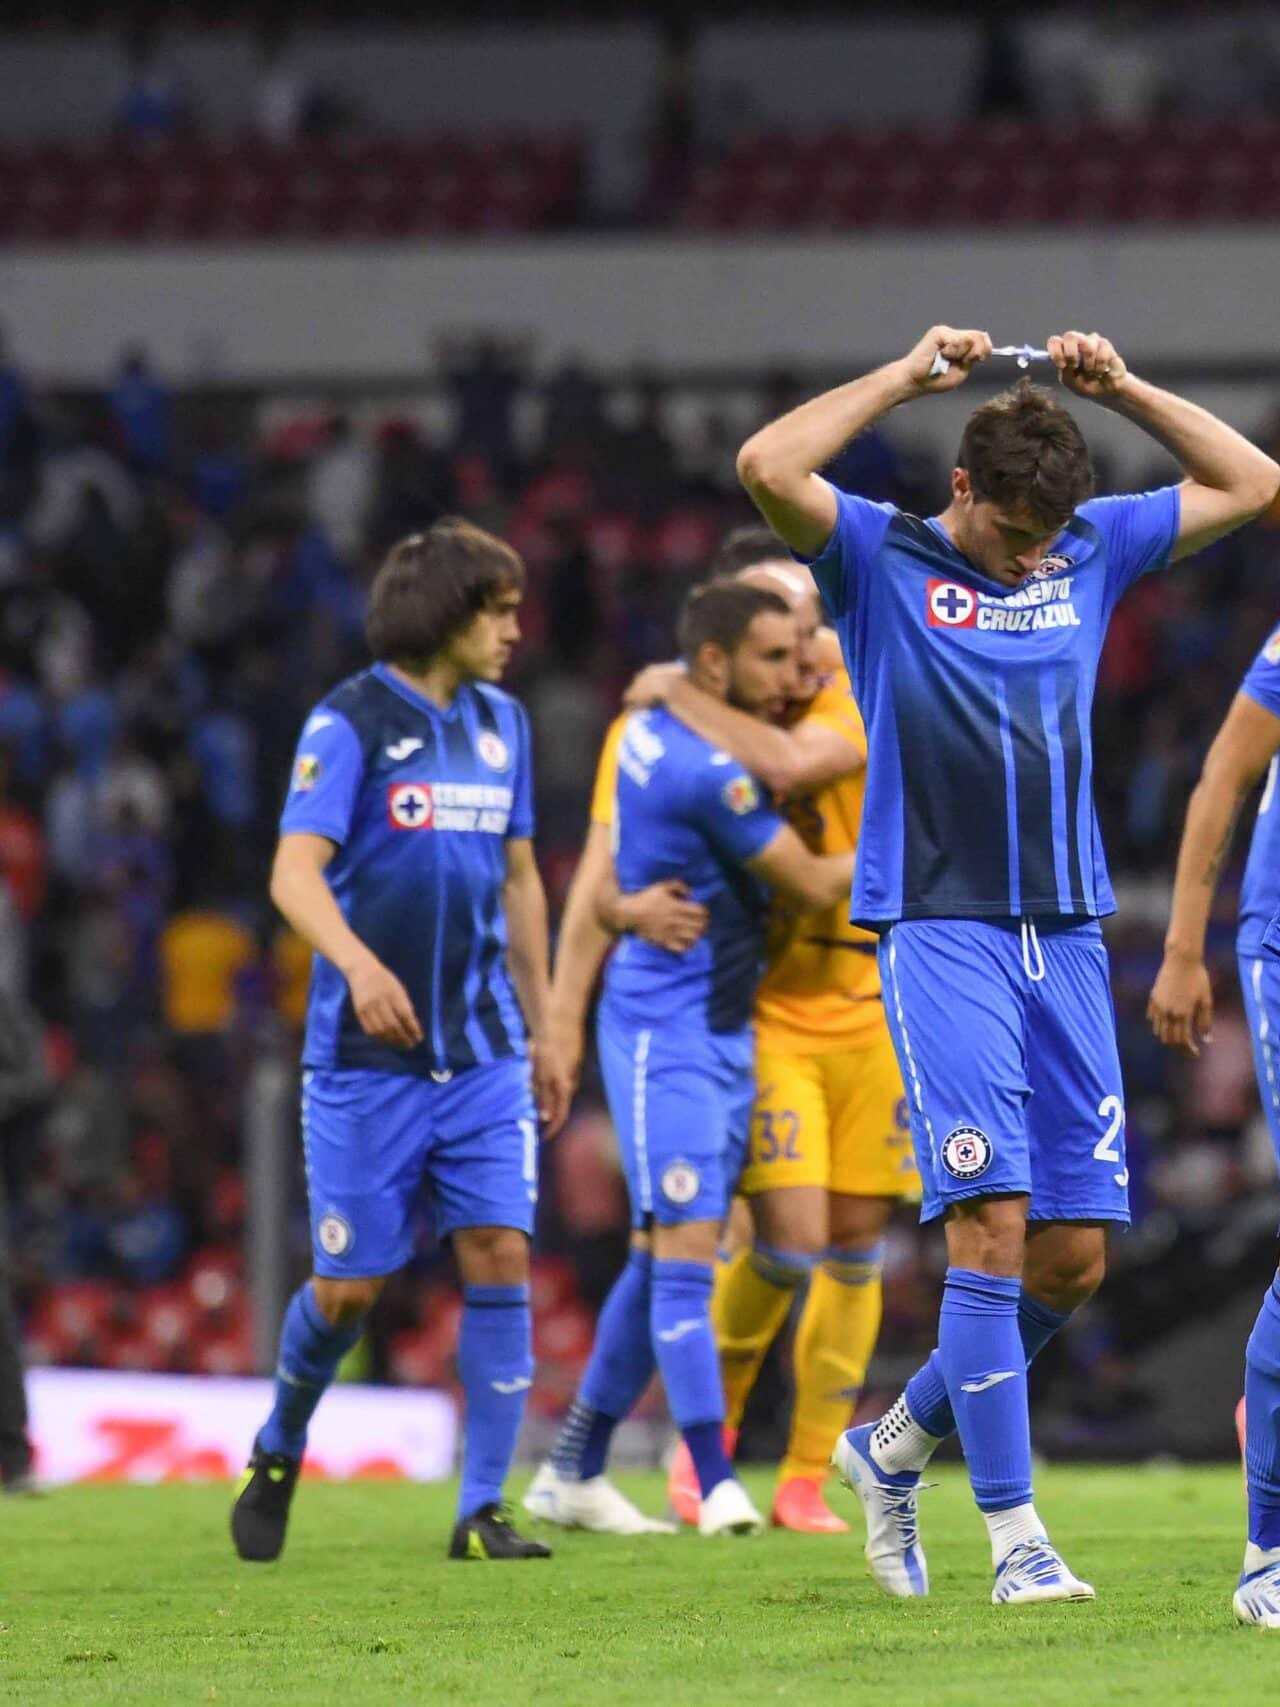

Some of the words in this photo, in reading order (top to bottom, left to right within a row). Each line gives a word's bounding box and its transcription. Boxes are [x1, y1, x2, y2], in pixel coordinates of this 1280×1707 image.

[976, 606, 1033, 632] CRUZ
[1031, 603, 1081, 630] AZUL
[753, 1109, 804, 1162] 32
